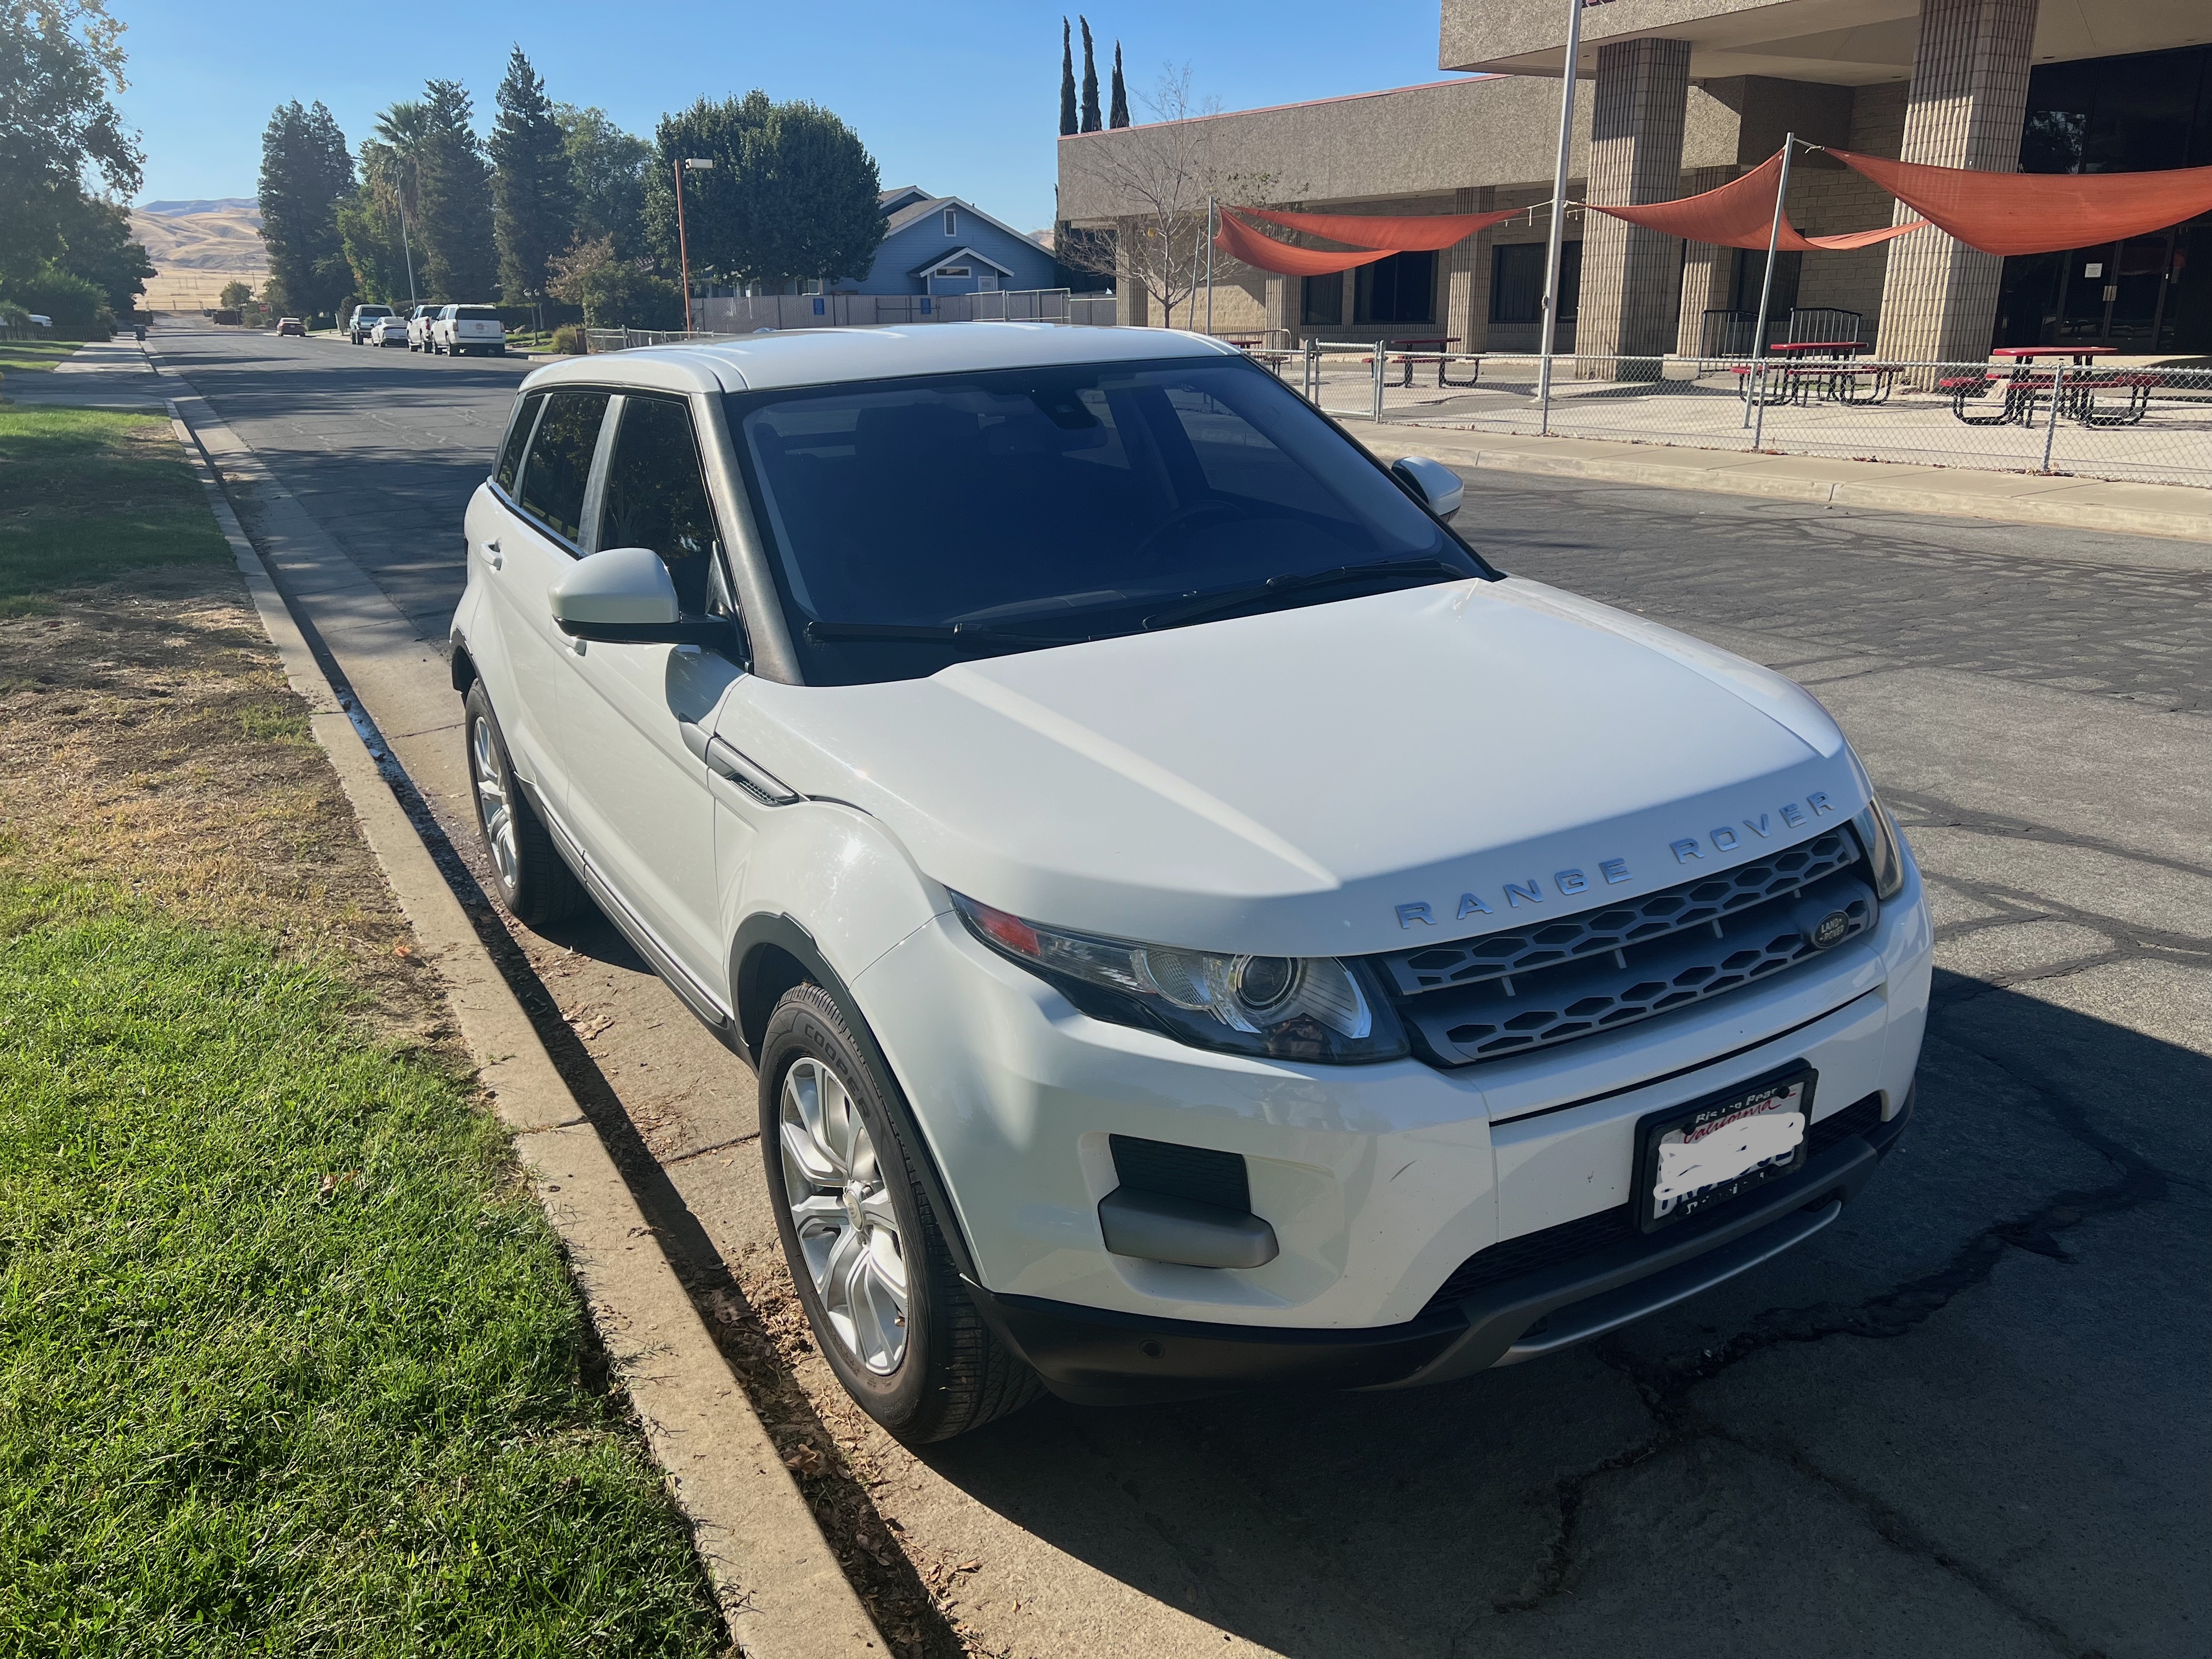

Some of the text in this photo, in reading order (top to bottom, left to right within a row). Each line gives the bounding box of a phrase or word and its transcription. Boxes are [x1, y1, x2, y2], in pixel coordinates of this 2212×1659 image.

[1395, 792, 1835, 928] RANGE ROVER
[1821, 918, 1839, 933] LAND
[805, 1023, 870, 1119] COOPER
